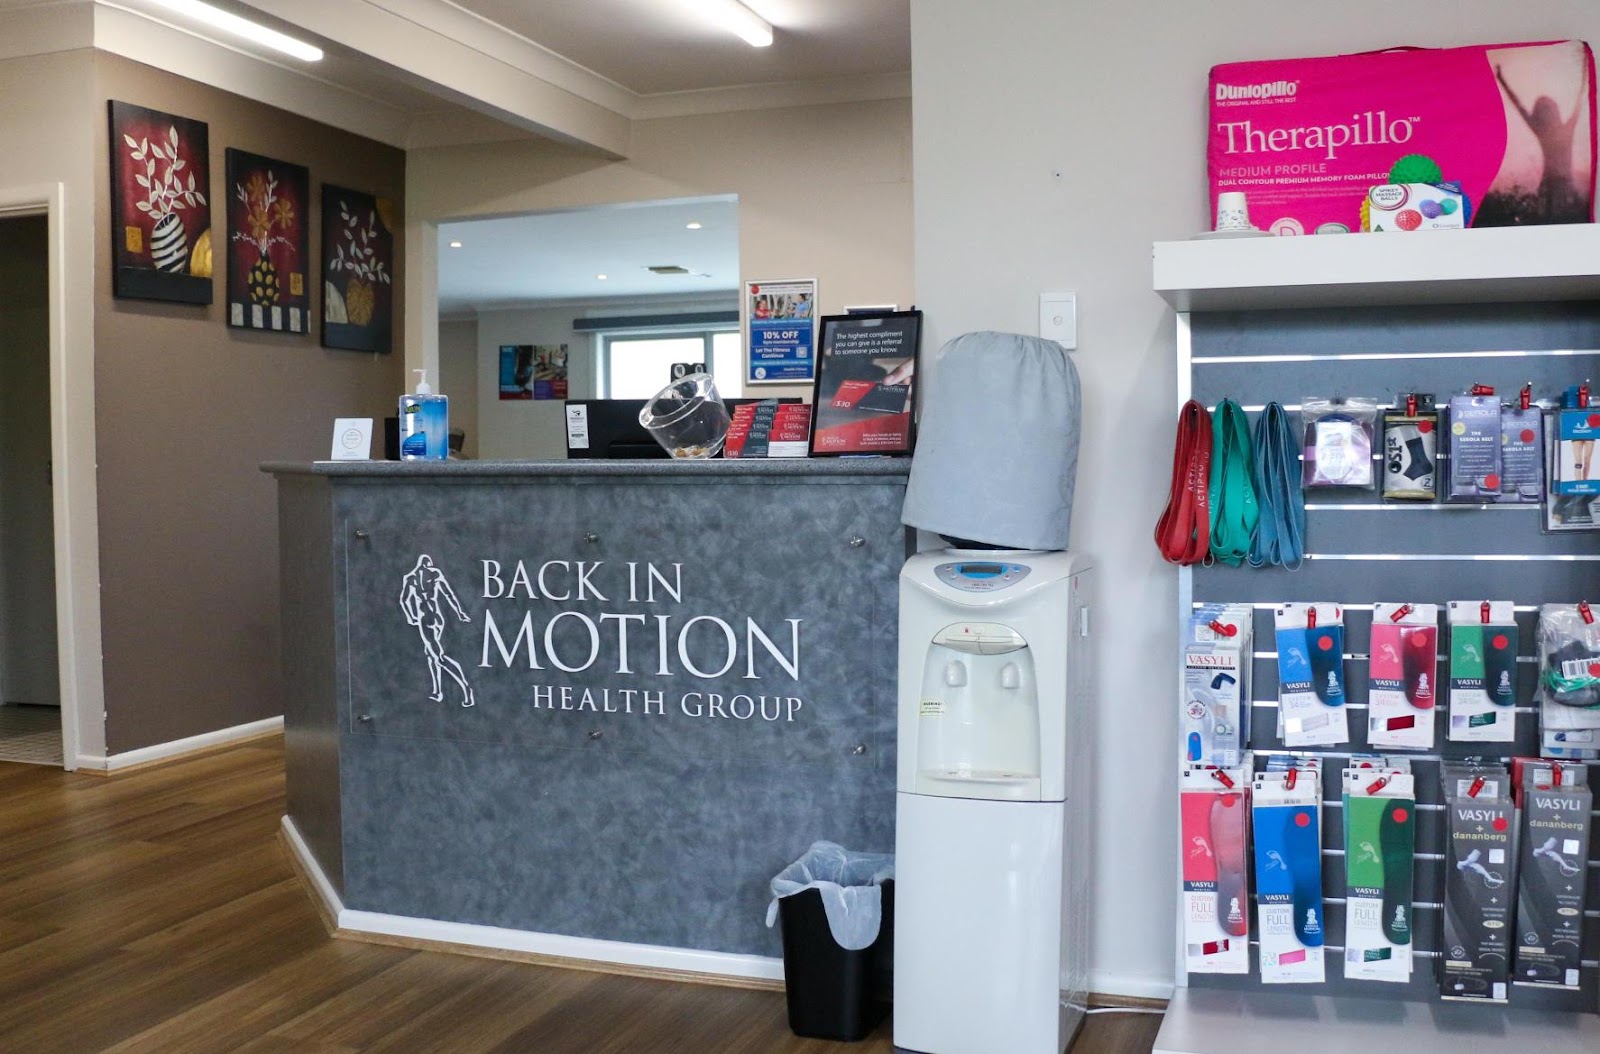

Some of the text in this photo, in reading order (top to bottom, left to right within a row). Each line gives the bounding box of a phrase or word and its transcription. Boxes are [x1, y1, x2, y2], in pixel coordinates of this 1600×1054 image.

[1219, 163, 1328, 178] MEDIUM PROFILE
[1218, 179, 1237, 187] DUAL
[1237, 178, 1275, 186] CONTOUR
[1310, 175, 1342, 183] MEMORY
[763, 330, 799, 340] 10% OFF
[847, 331, 868, 340] highest
[869, 331, 903, 339] compliment
[858, 340, 870, 348] give
[481, 559, 684, 604] BACK IN
[477, 608, 804, 681] MOTION
[1187, 655, 1233, 666] VASYLI
[1286, 681, 1310, 689] VASYLI
[1375, 679, 1400, 687] VASYLI
[533, 685, 802, 722] HEALTH GROUP
[1535, 797, 1581, 811] VASYLI
[1529, 819, 1584, 831] dananberg
[1453, 831, 1507, 842] dananberg
[1355, 887, 1379, 895] VASYLI
[1191, 902, 1214, 913] FULL
[1354, 908, 1378, 919] FULL
[1266, 914, 1290, 925] FULL
